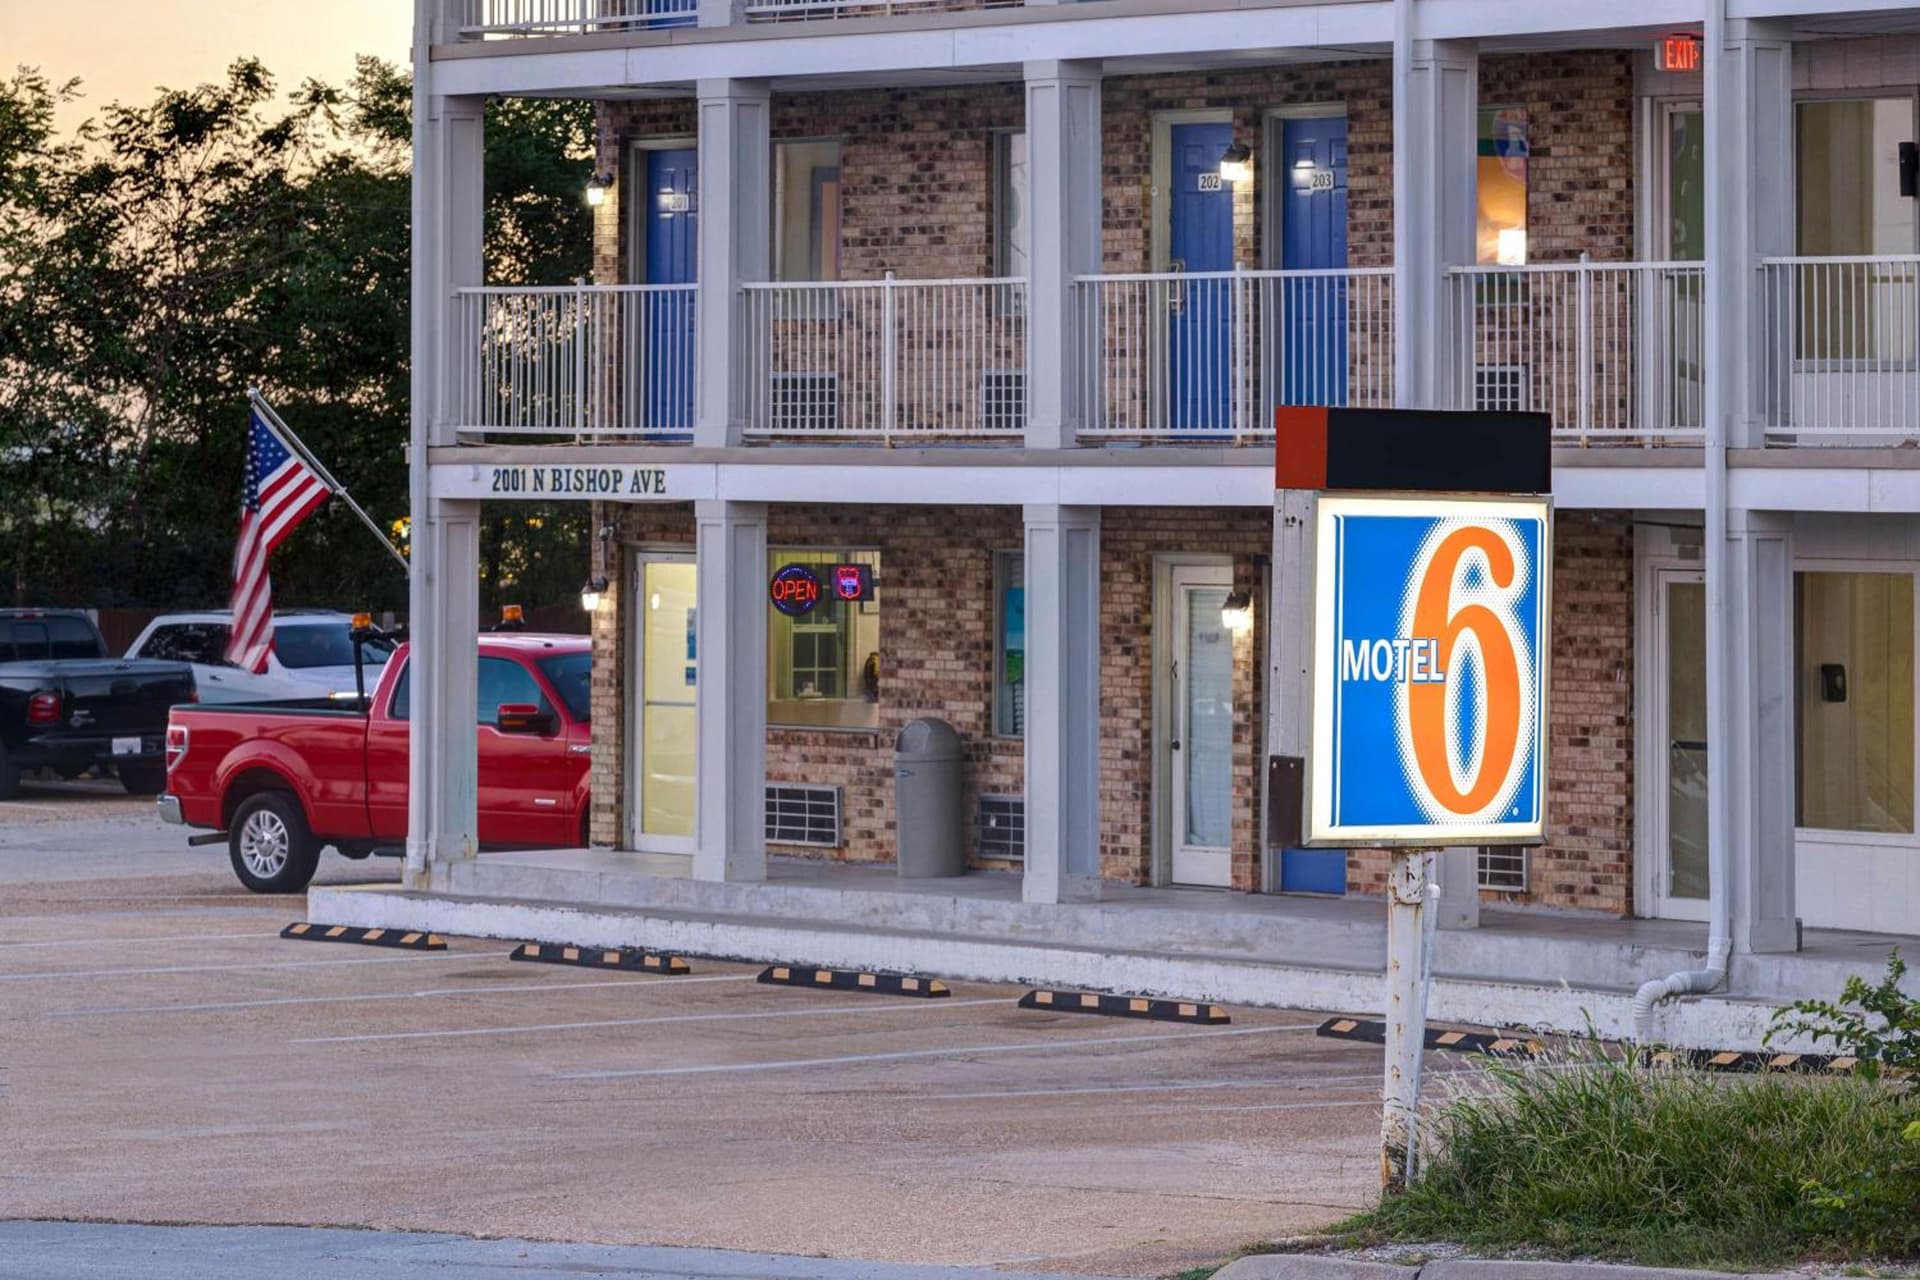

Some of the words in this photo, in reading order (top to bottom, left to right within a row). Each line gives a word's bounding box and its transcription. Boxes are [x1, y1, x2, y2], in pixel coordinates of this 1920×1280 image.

[1666, 40, 1696, 69] EXIT
[1201, 175, 1219, 188] 202
[1313, 174, 1332, 188] 203
[492, 469, 526, 492] 2001
[533, 468, 545, 492] N
[551, 468, 623, 493] BISHOP
[630, 470, 666, 494] AVE
[772, 580, 817, 600] OPEN
[1343, 639, 1444, 682] MOTEL
[1409, 526, 1521, 815] 6
